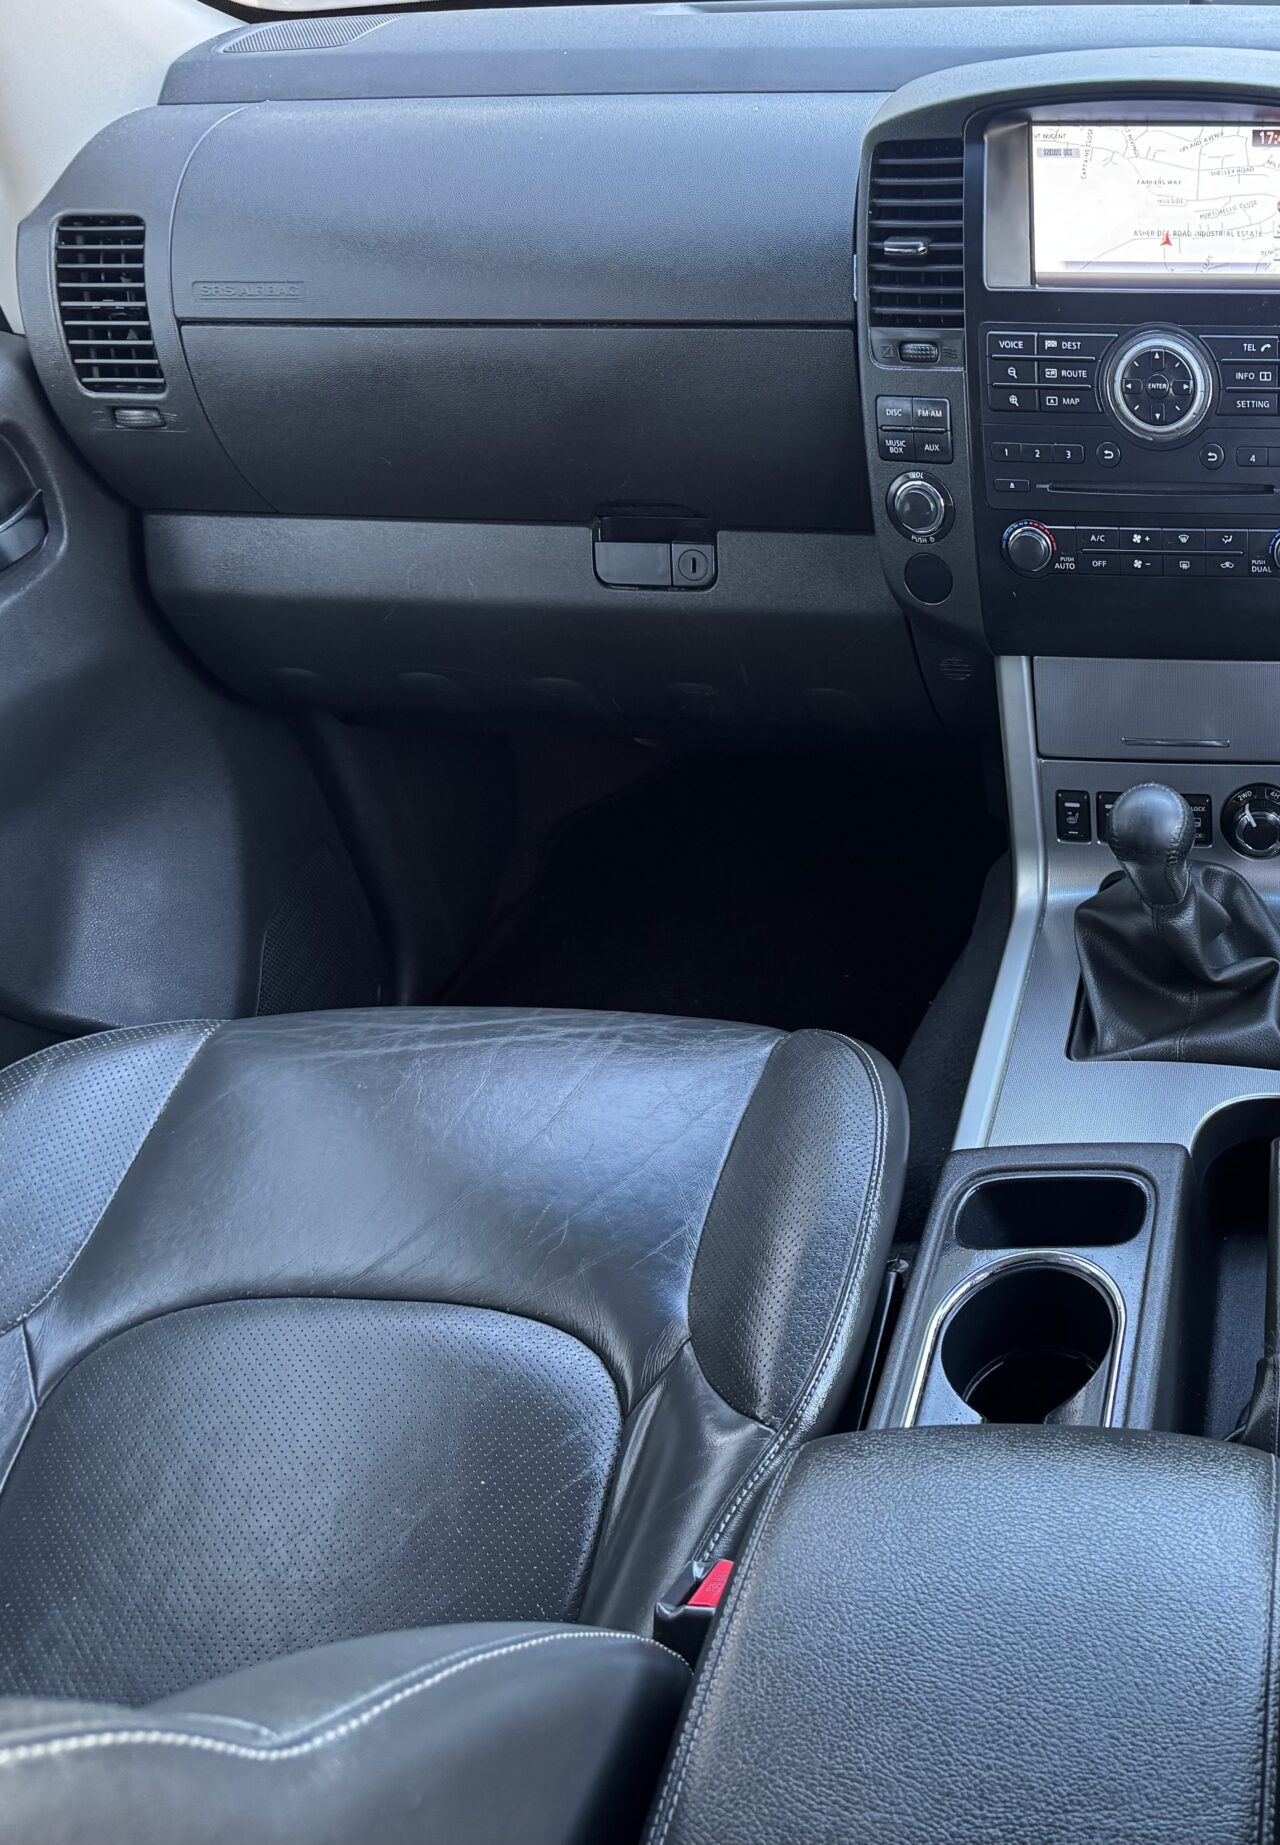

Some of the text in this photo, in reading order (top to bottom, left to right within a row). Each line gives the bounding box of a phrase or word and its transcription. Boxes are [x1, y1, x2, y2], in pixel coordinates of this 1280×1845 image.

[1194, 230, 1235, 238] INDUSTRIAL
[1237, 230, 1263, 238] ESTATE
[998, 340, 1024, 349] VOICE
[1061, 341, 1081, 350] DEST
[1242, 343, 1256, 351] TEL
[1061, 369, 1087, 378] ROUTE
[1235, 372, 1255, 380] INFO
[1236, 400, 1270, 408] SETTING
[886, 408, 902, 416] DISC
[885, 439, 906, 447] MUSIC
[889, 446, 904, 454] BOX
[924, 443, 940, 452] AUX
[1034, 449, 1040, 458] 2
[1065, 450, 1071, 459] 3
[1250, 454, 1256, 463] 4
[911, 534, 928, 544] PUSH
[1090, 534, 1105, 542] A/C
[1054, 562, 1075, 570] AUTO
[1251, 565, 1273, 573] DUAL
[1237, 790, 1253, 801] 2WD
[1269, 790, 1280, 800] 4H
